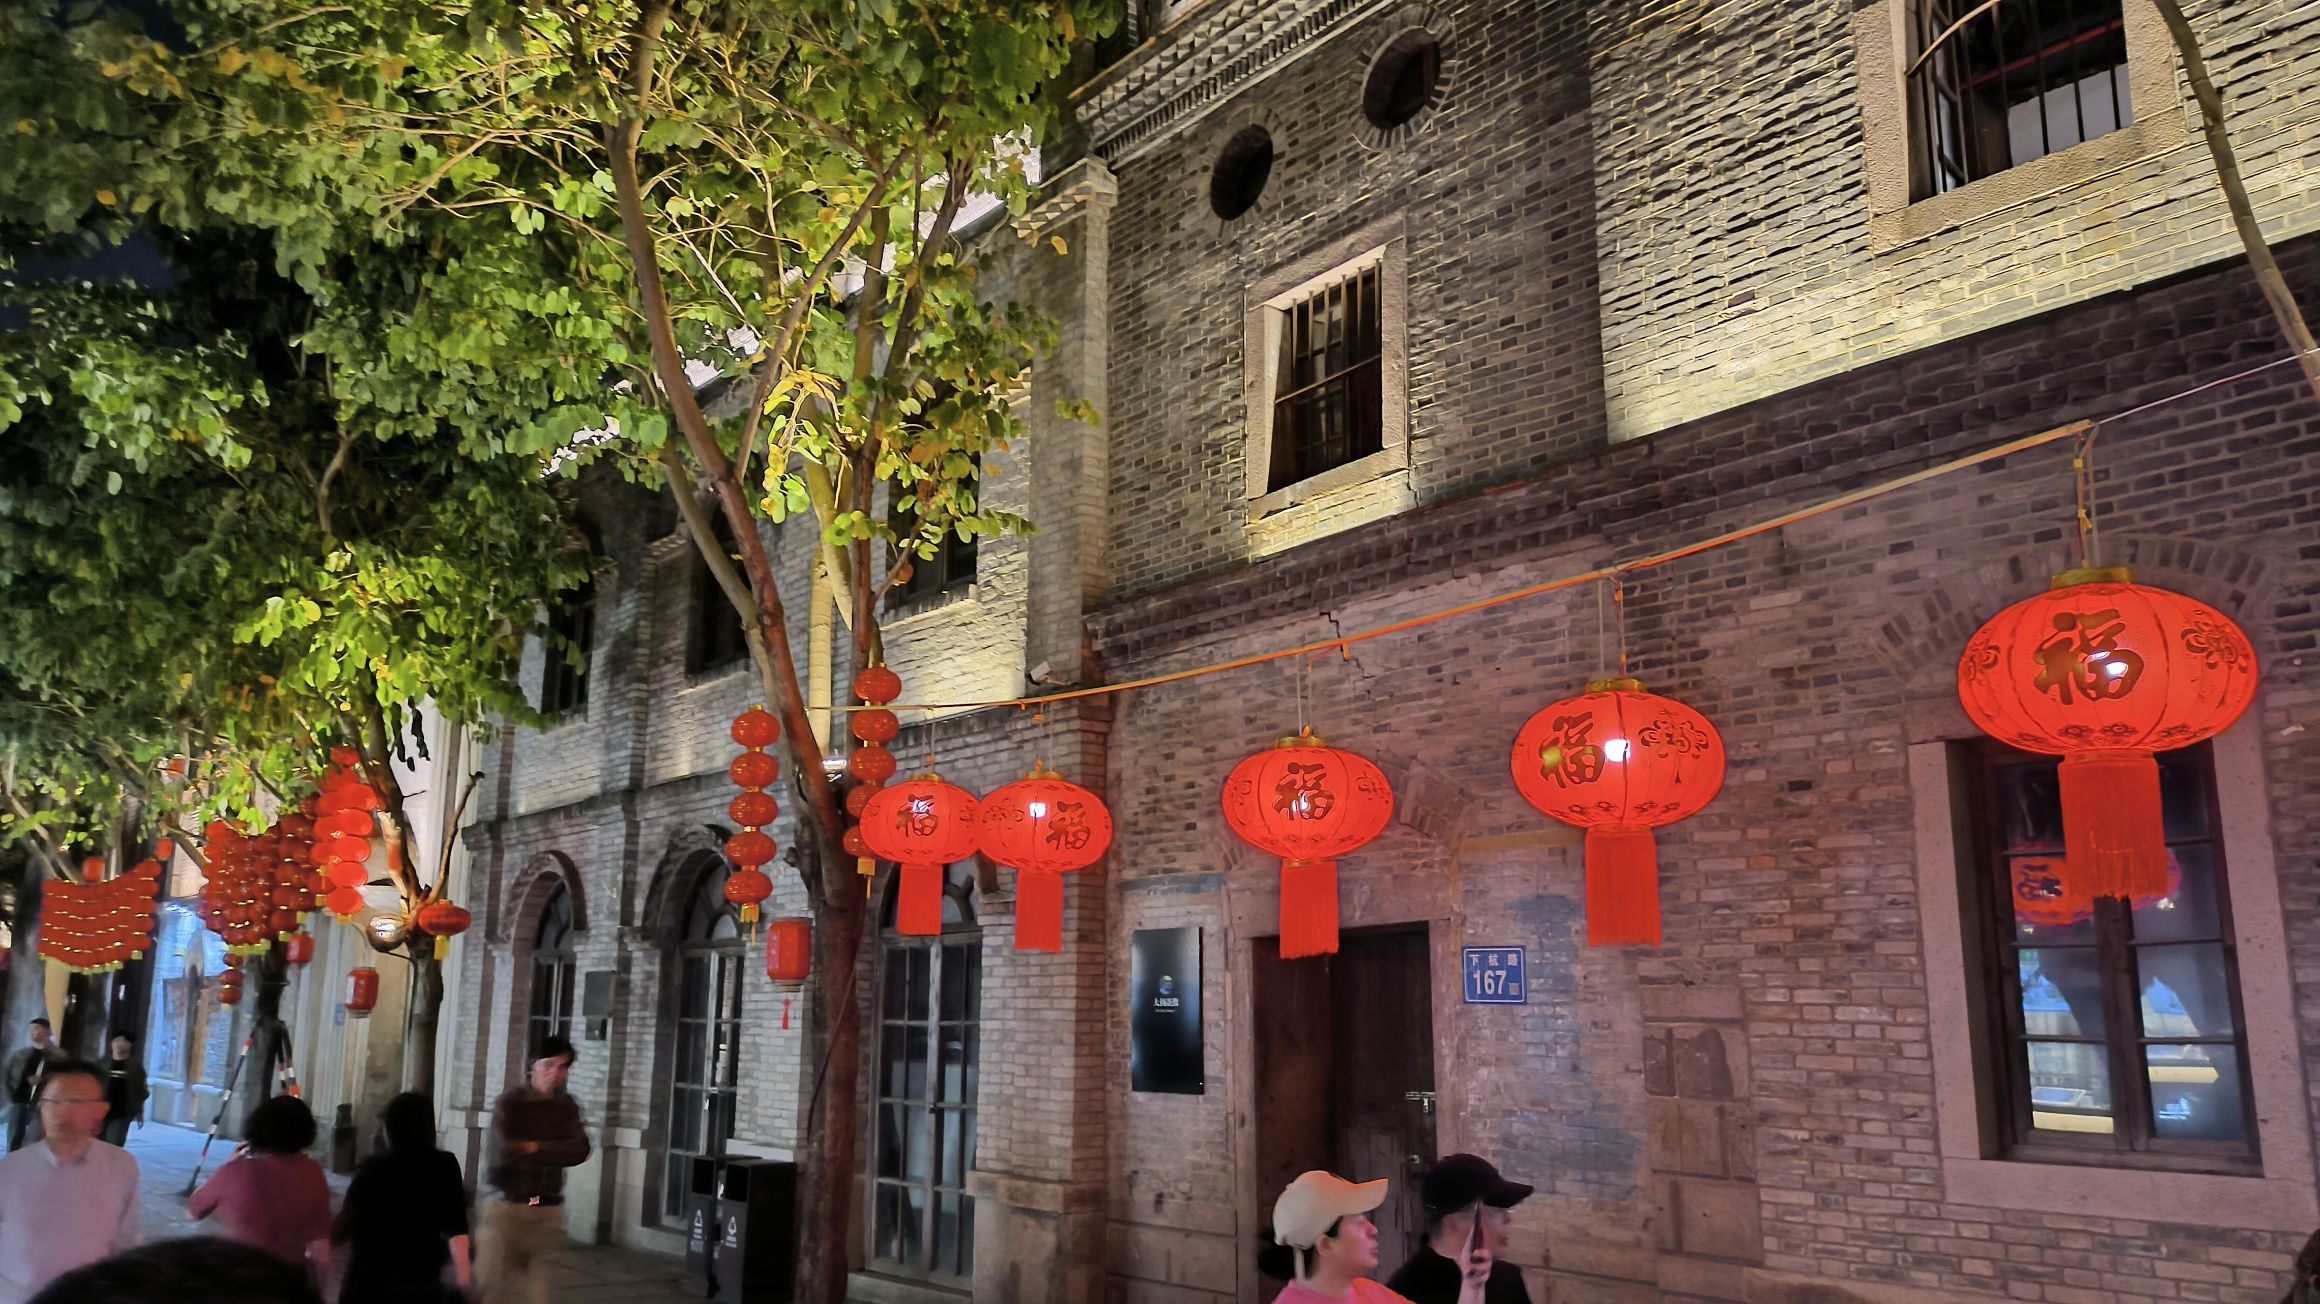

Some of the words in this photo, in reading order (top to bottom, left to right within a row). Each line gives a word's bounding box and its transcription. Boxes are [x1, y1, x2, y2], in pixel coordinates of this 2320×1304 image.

[2033, 609, 2145, 706] 福
[1539, 711, 1606, 789] 福
[1272, 762, 1336, 821] 福
[1044, 801, 1092, 850] 福
[1473, 969, 1507, 995] 167
